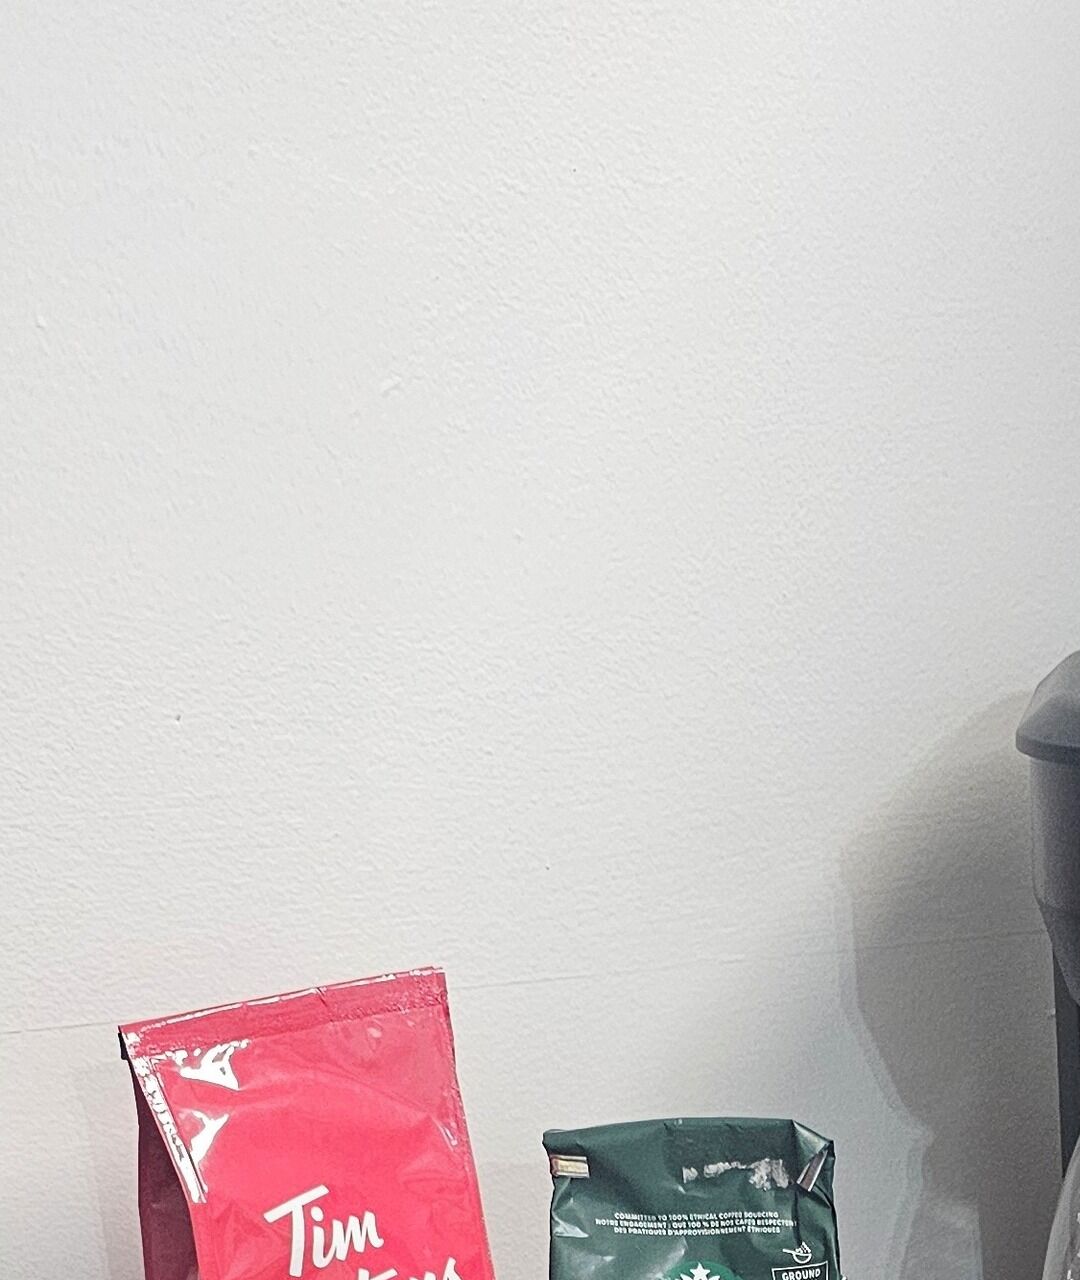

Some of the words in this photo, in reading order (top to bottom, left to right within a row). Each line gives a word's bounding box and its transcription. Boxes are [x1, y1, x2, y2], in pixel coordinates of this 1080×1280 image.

[263, 1184, 385, 1278] Tim
[614, 1212, 657, 1221] COMMITTED
[689, 1213, 718, 1221] ETHICAL
[718, 1211, 743, 1219] COFFEE
[744, 1211, 779, 1219] SOURCING
